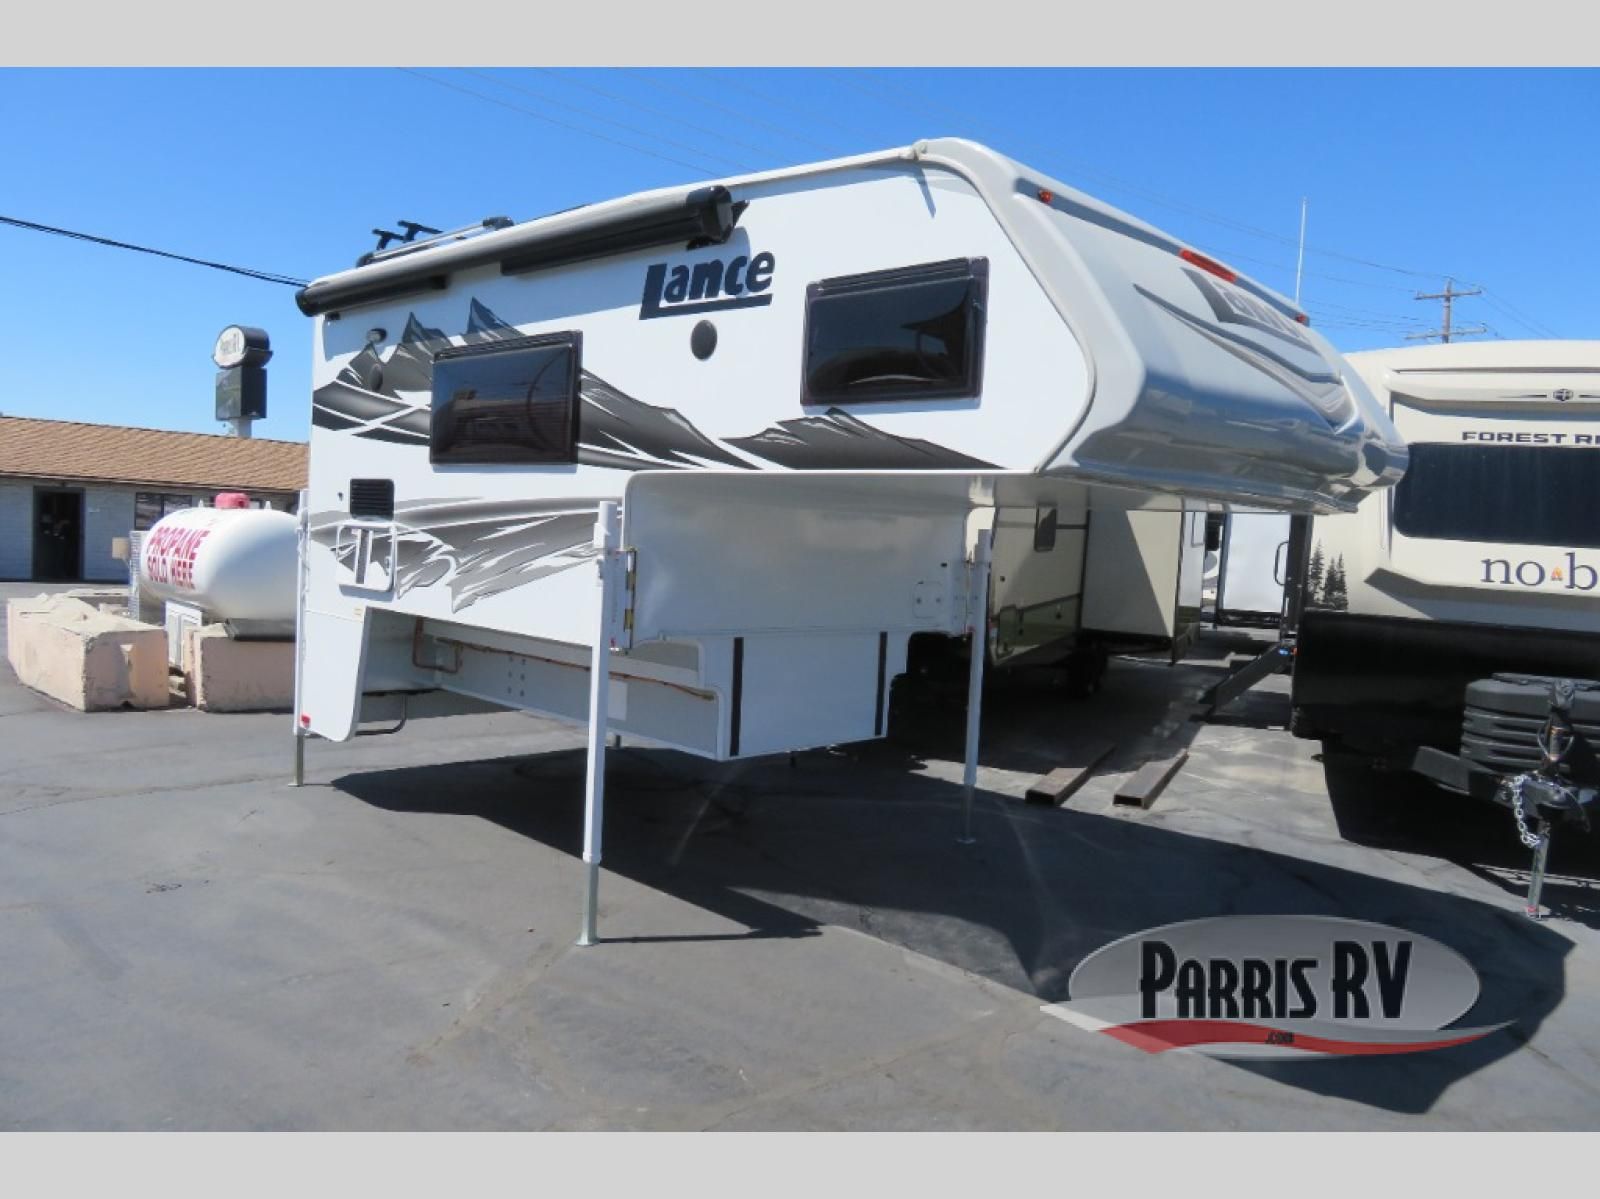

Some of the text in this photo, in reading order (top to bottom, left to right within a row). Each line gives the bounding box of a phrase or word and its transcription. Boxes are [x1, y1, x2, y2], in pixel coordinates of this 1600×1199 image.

[639, 251, 775, 320] Lance
[1461, 431, 1567, 444] FOREST
[146, 526, 211, 560] PROPANE
[147, 555, 196, 590] SOLD HERE
